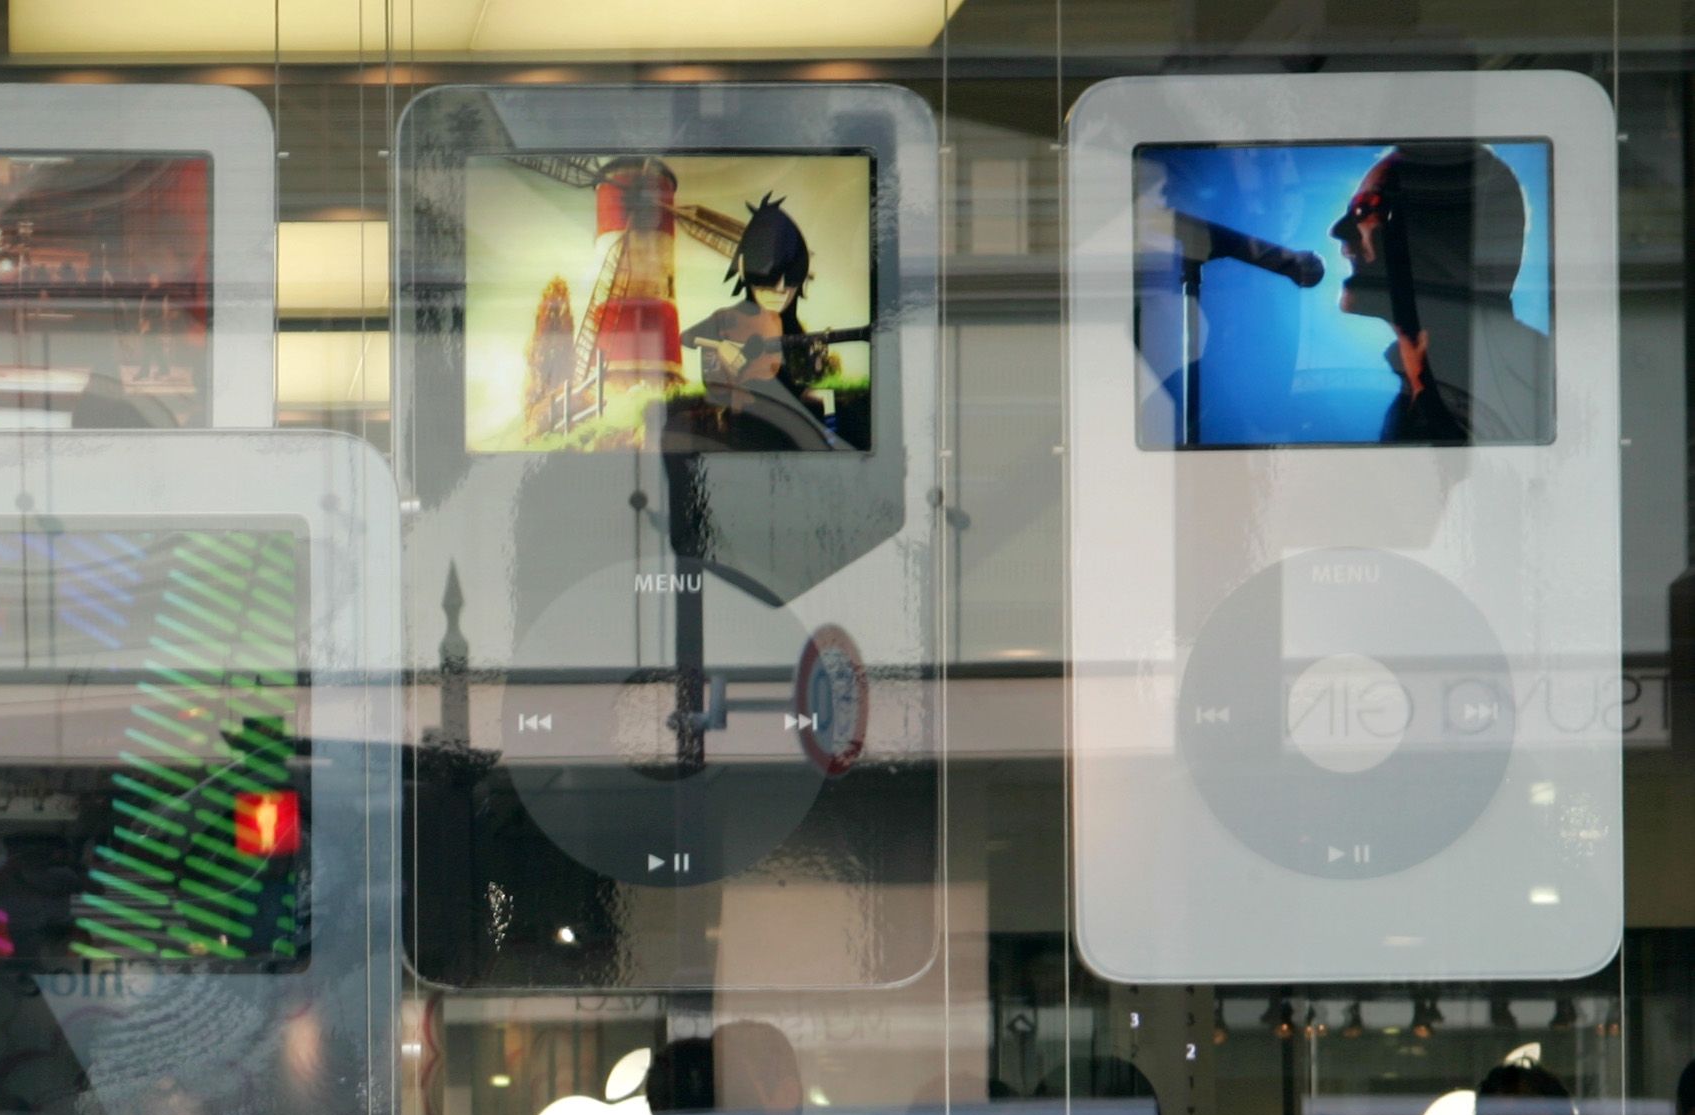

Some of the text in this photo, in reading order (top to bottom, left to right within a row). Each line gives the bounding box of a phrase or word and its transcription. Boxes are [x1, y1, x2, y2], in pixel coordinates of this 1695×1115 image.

[1312, 563, 1380, 585] MENU
[634, 573, 702, 595] MENU
[1129, 1012, 1140, 1028] 3
[1186, 1043, 1196, 1060] 2
